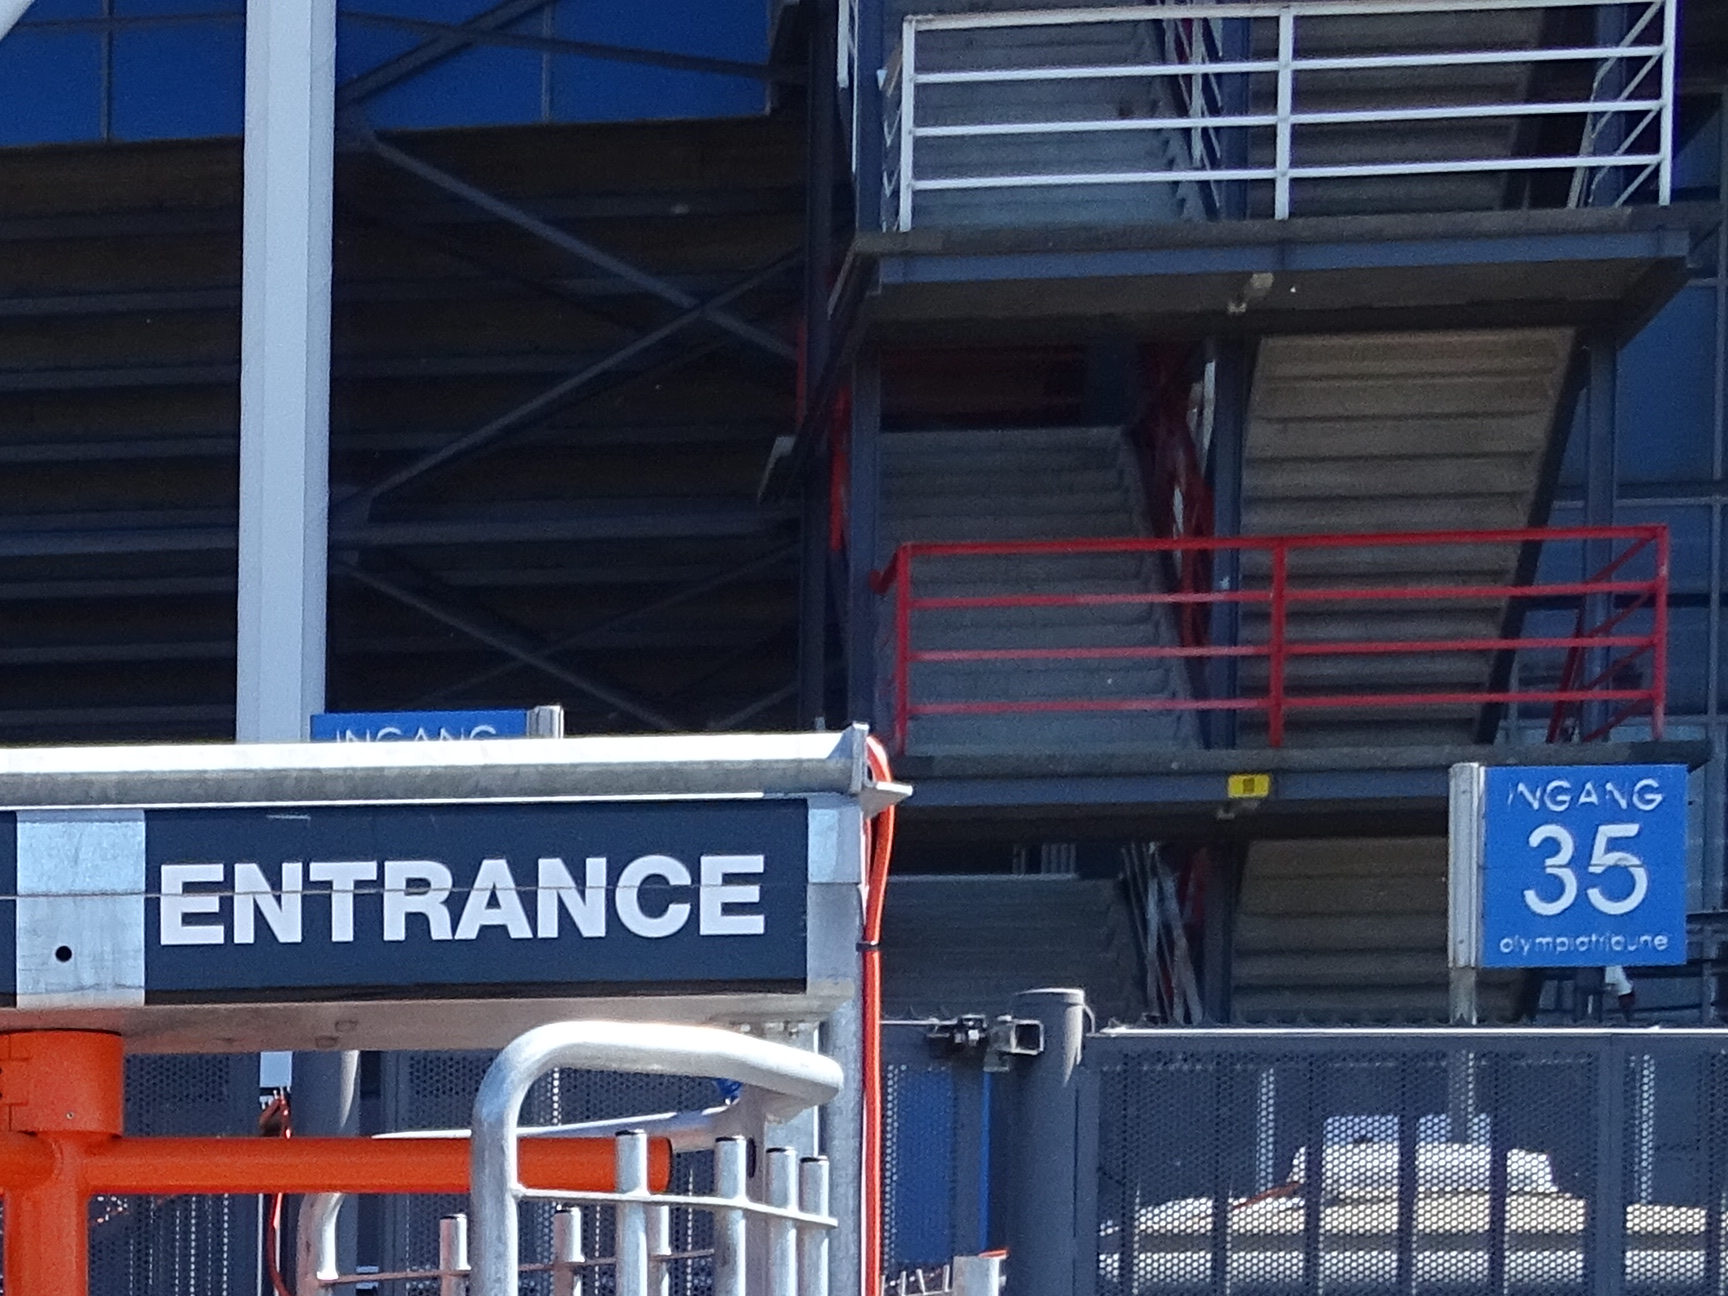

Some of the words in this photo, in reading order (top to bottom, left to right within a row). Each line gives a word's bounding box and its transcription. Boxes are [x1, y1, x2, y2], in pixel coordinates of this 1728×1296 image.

[1507, 778, 1663, 812] INGANG
[160, 854, 765, 945] ENTRANCE
[1523, 823, 1648, 916] 35
